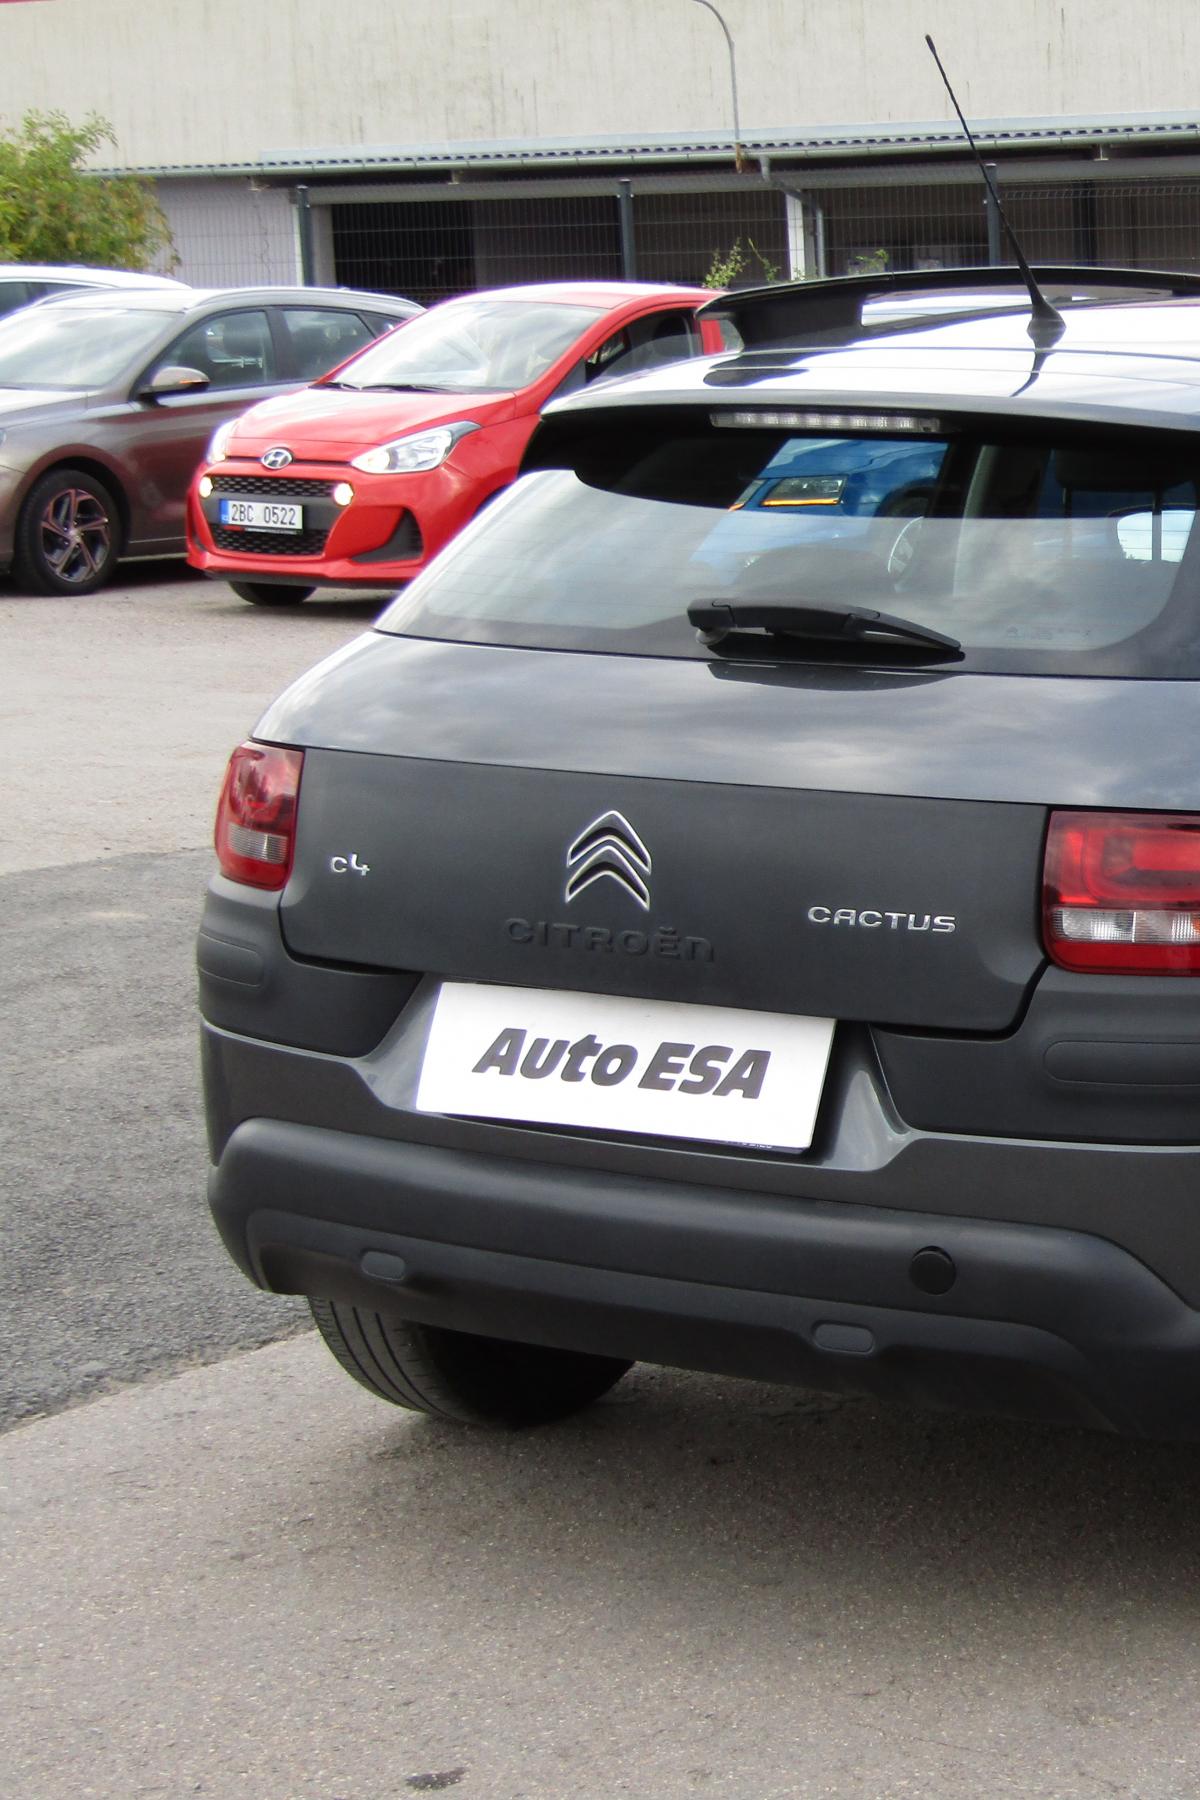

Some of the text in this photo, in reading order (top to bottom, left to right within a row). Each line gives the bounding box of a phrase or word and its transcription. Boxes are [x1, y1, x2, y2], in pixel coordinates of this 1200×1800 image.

[231, 504, 296, 526] 2BC 0522
[807, 906, 956, 933] CACTUS
[471, 1027, 772, 1100] Auto ESA
